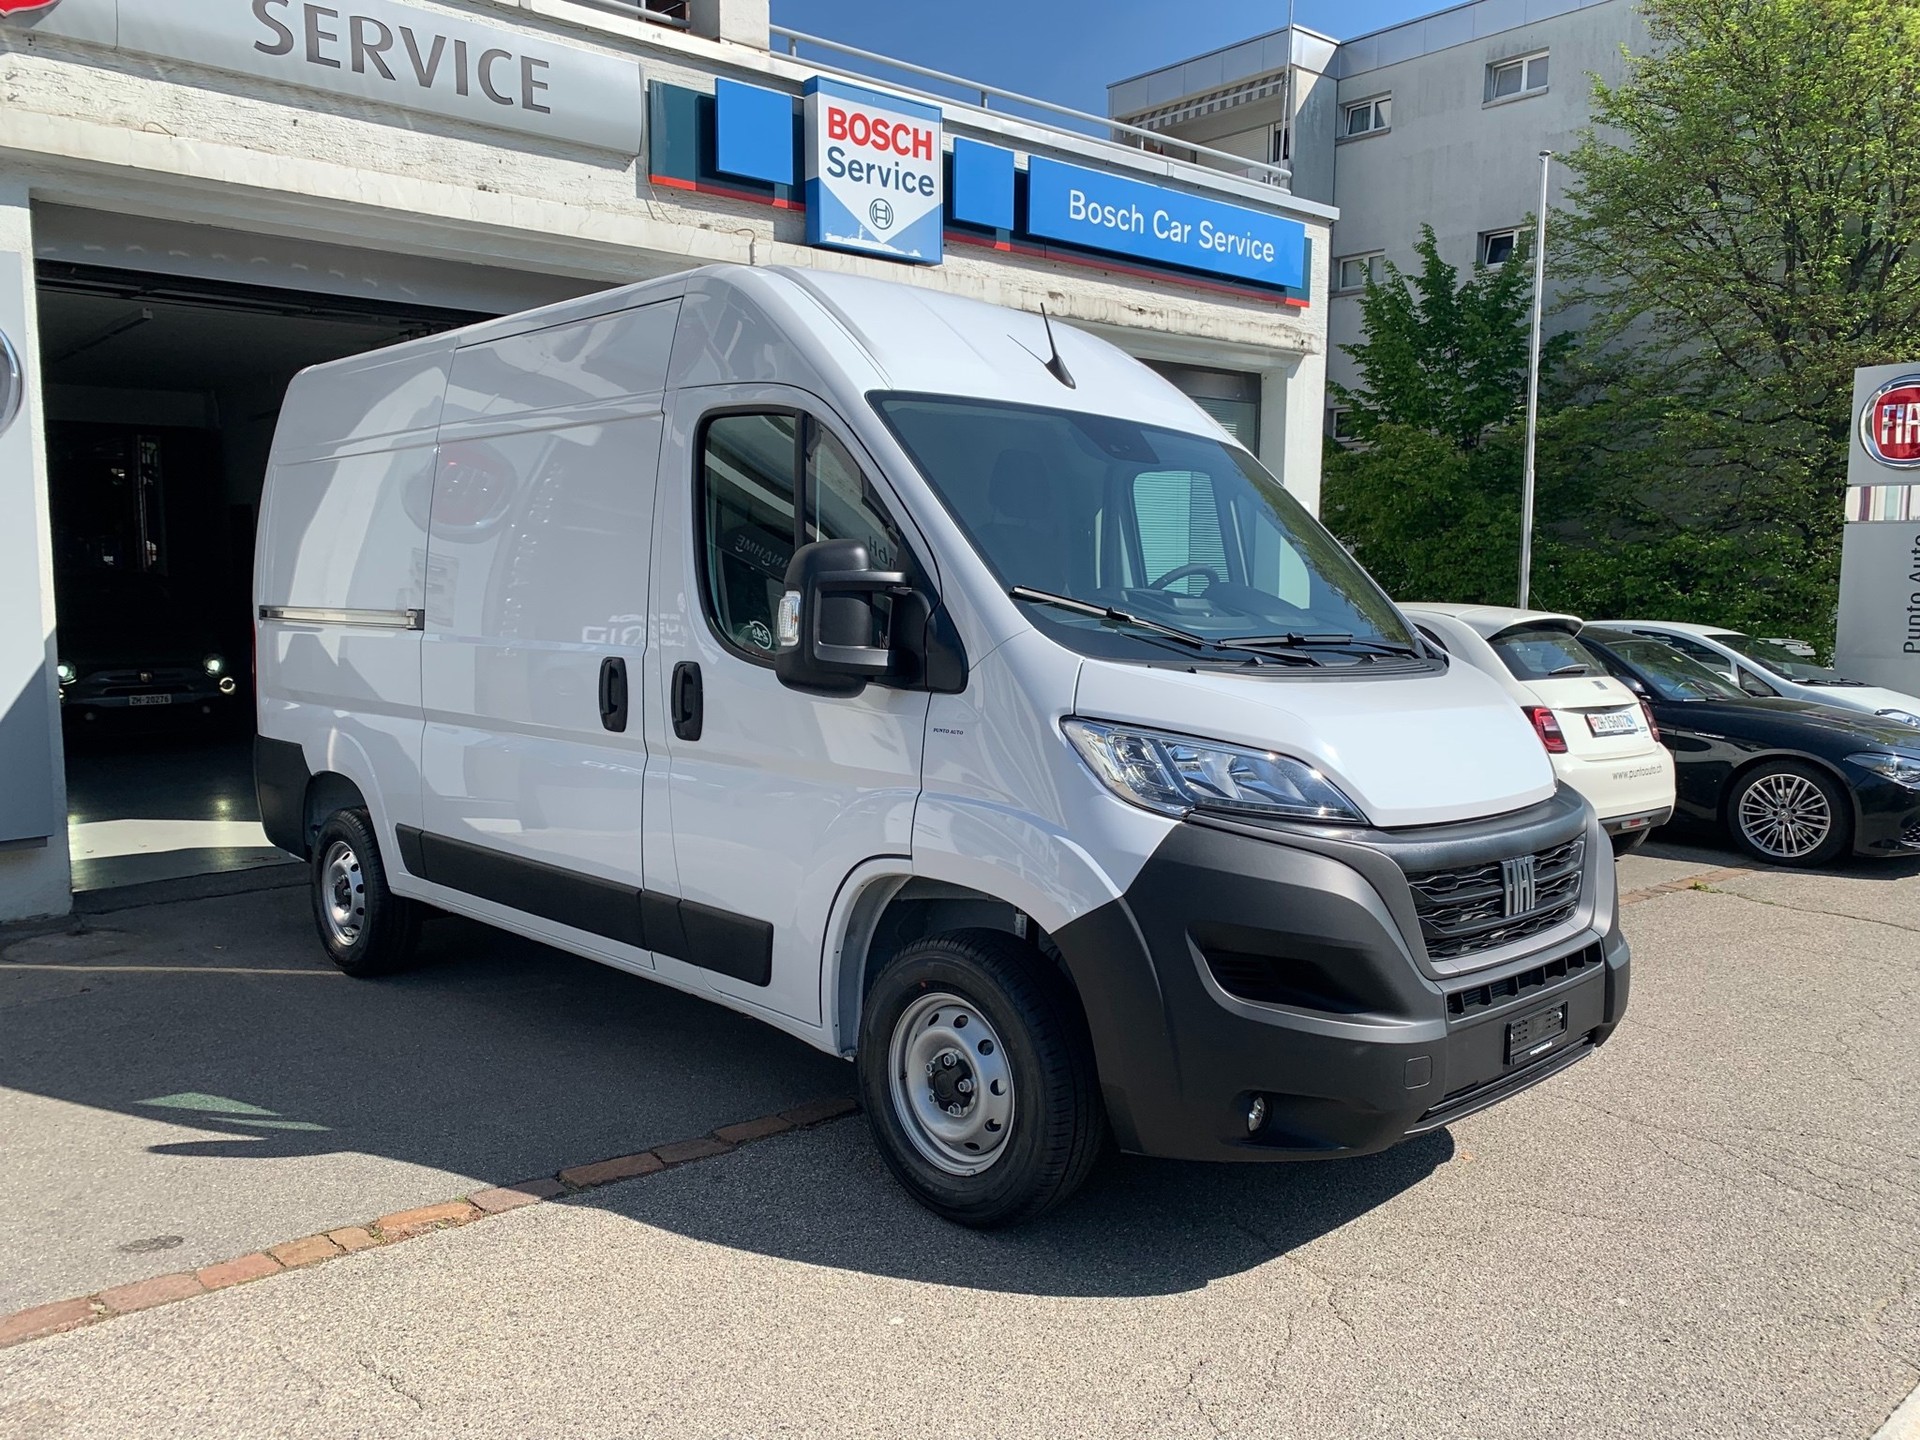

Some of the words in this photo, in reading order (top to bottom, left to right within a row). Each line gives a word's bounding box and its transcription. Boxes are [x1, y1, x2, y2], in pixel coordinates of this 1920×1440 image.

[251, 0, 550, 114] SERVICE
[828, 106, 932, 161] BOSCH
[826, 146, 935, 197] Service
[1069, 189, 1144, 234] Bosch
[1153, 209, 1191, 243] Car
[1198, 220, 1275, 262] Service
[933, 727, 949, 735] PUNTO
[1501, 855, 1536, 917] FIAT
